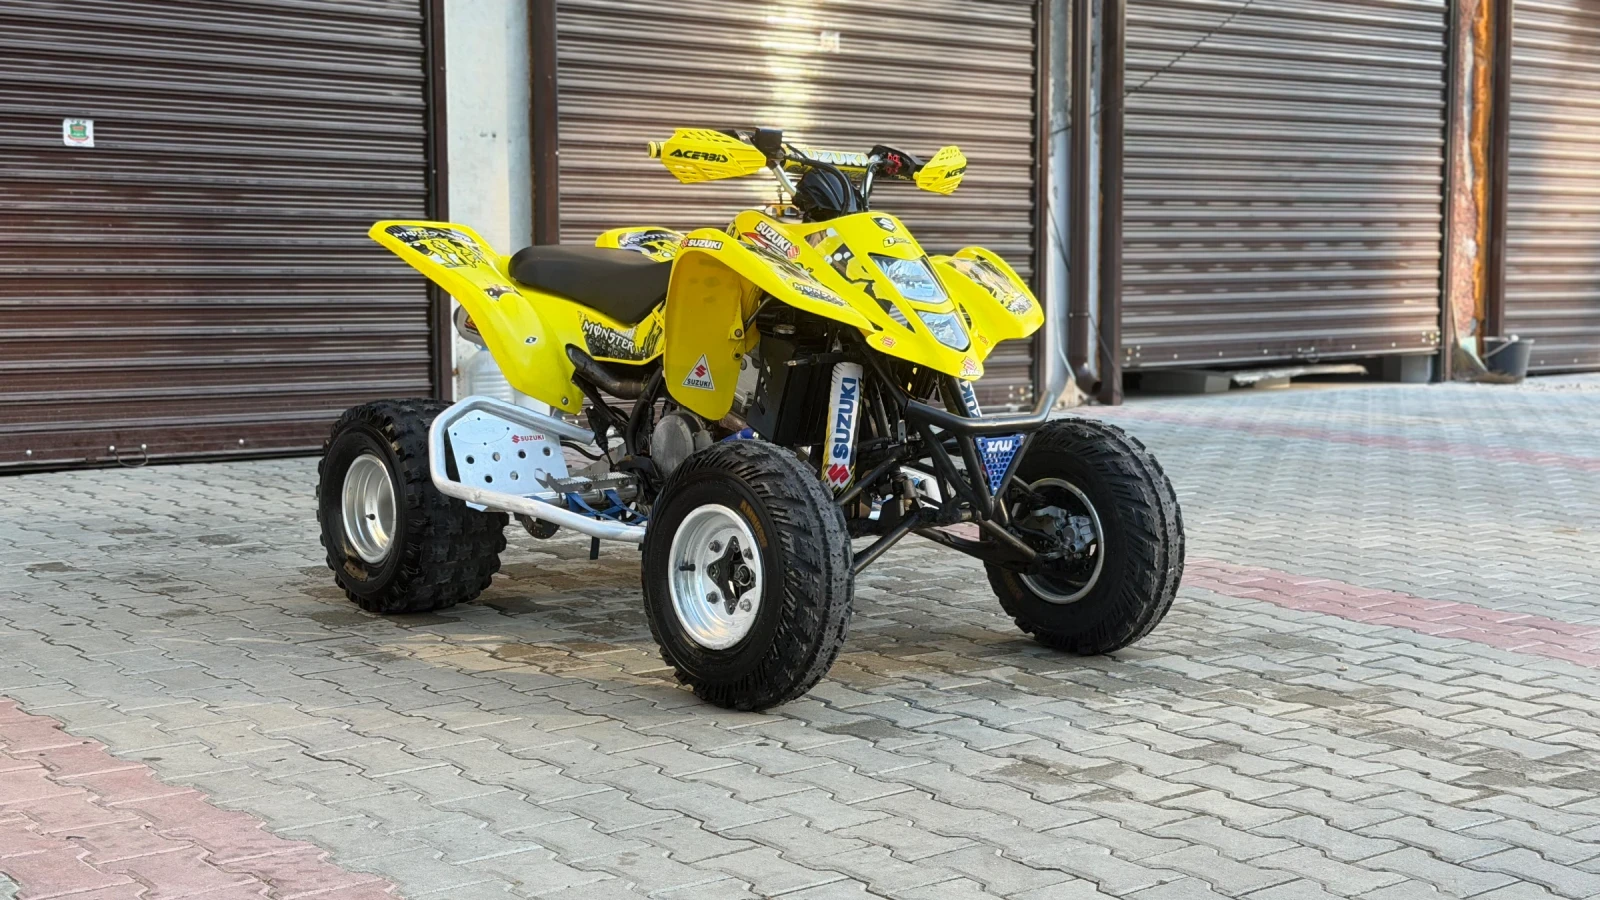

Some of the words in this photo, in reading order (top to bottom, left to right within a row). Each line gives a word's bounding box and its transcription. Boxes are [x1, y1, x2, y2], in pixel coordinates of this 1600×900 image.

[669, 149, 729, 163] ACERBIS
[802, 150, 869, 167] UZUKI
[756, 221, 793, 252] SUZUKI
[687, 239, 723, 250] SUZUKI
[687, 378, 711, 388] SUZUKI
[833, 377, 857, 460] SUZUKI
[520, 434, 545, 442] SUZUKI
